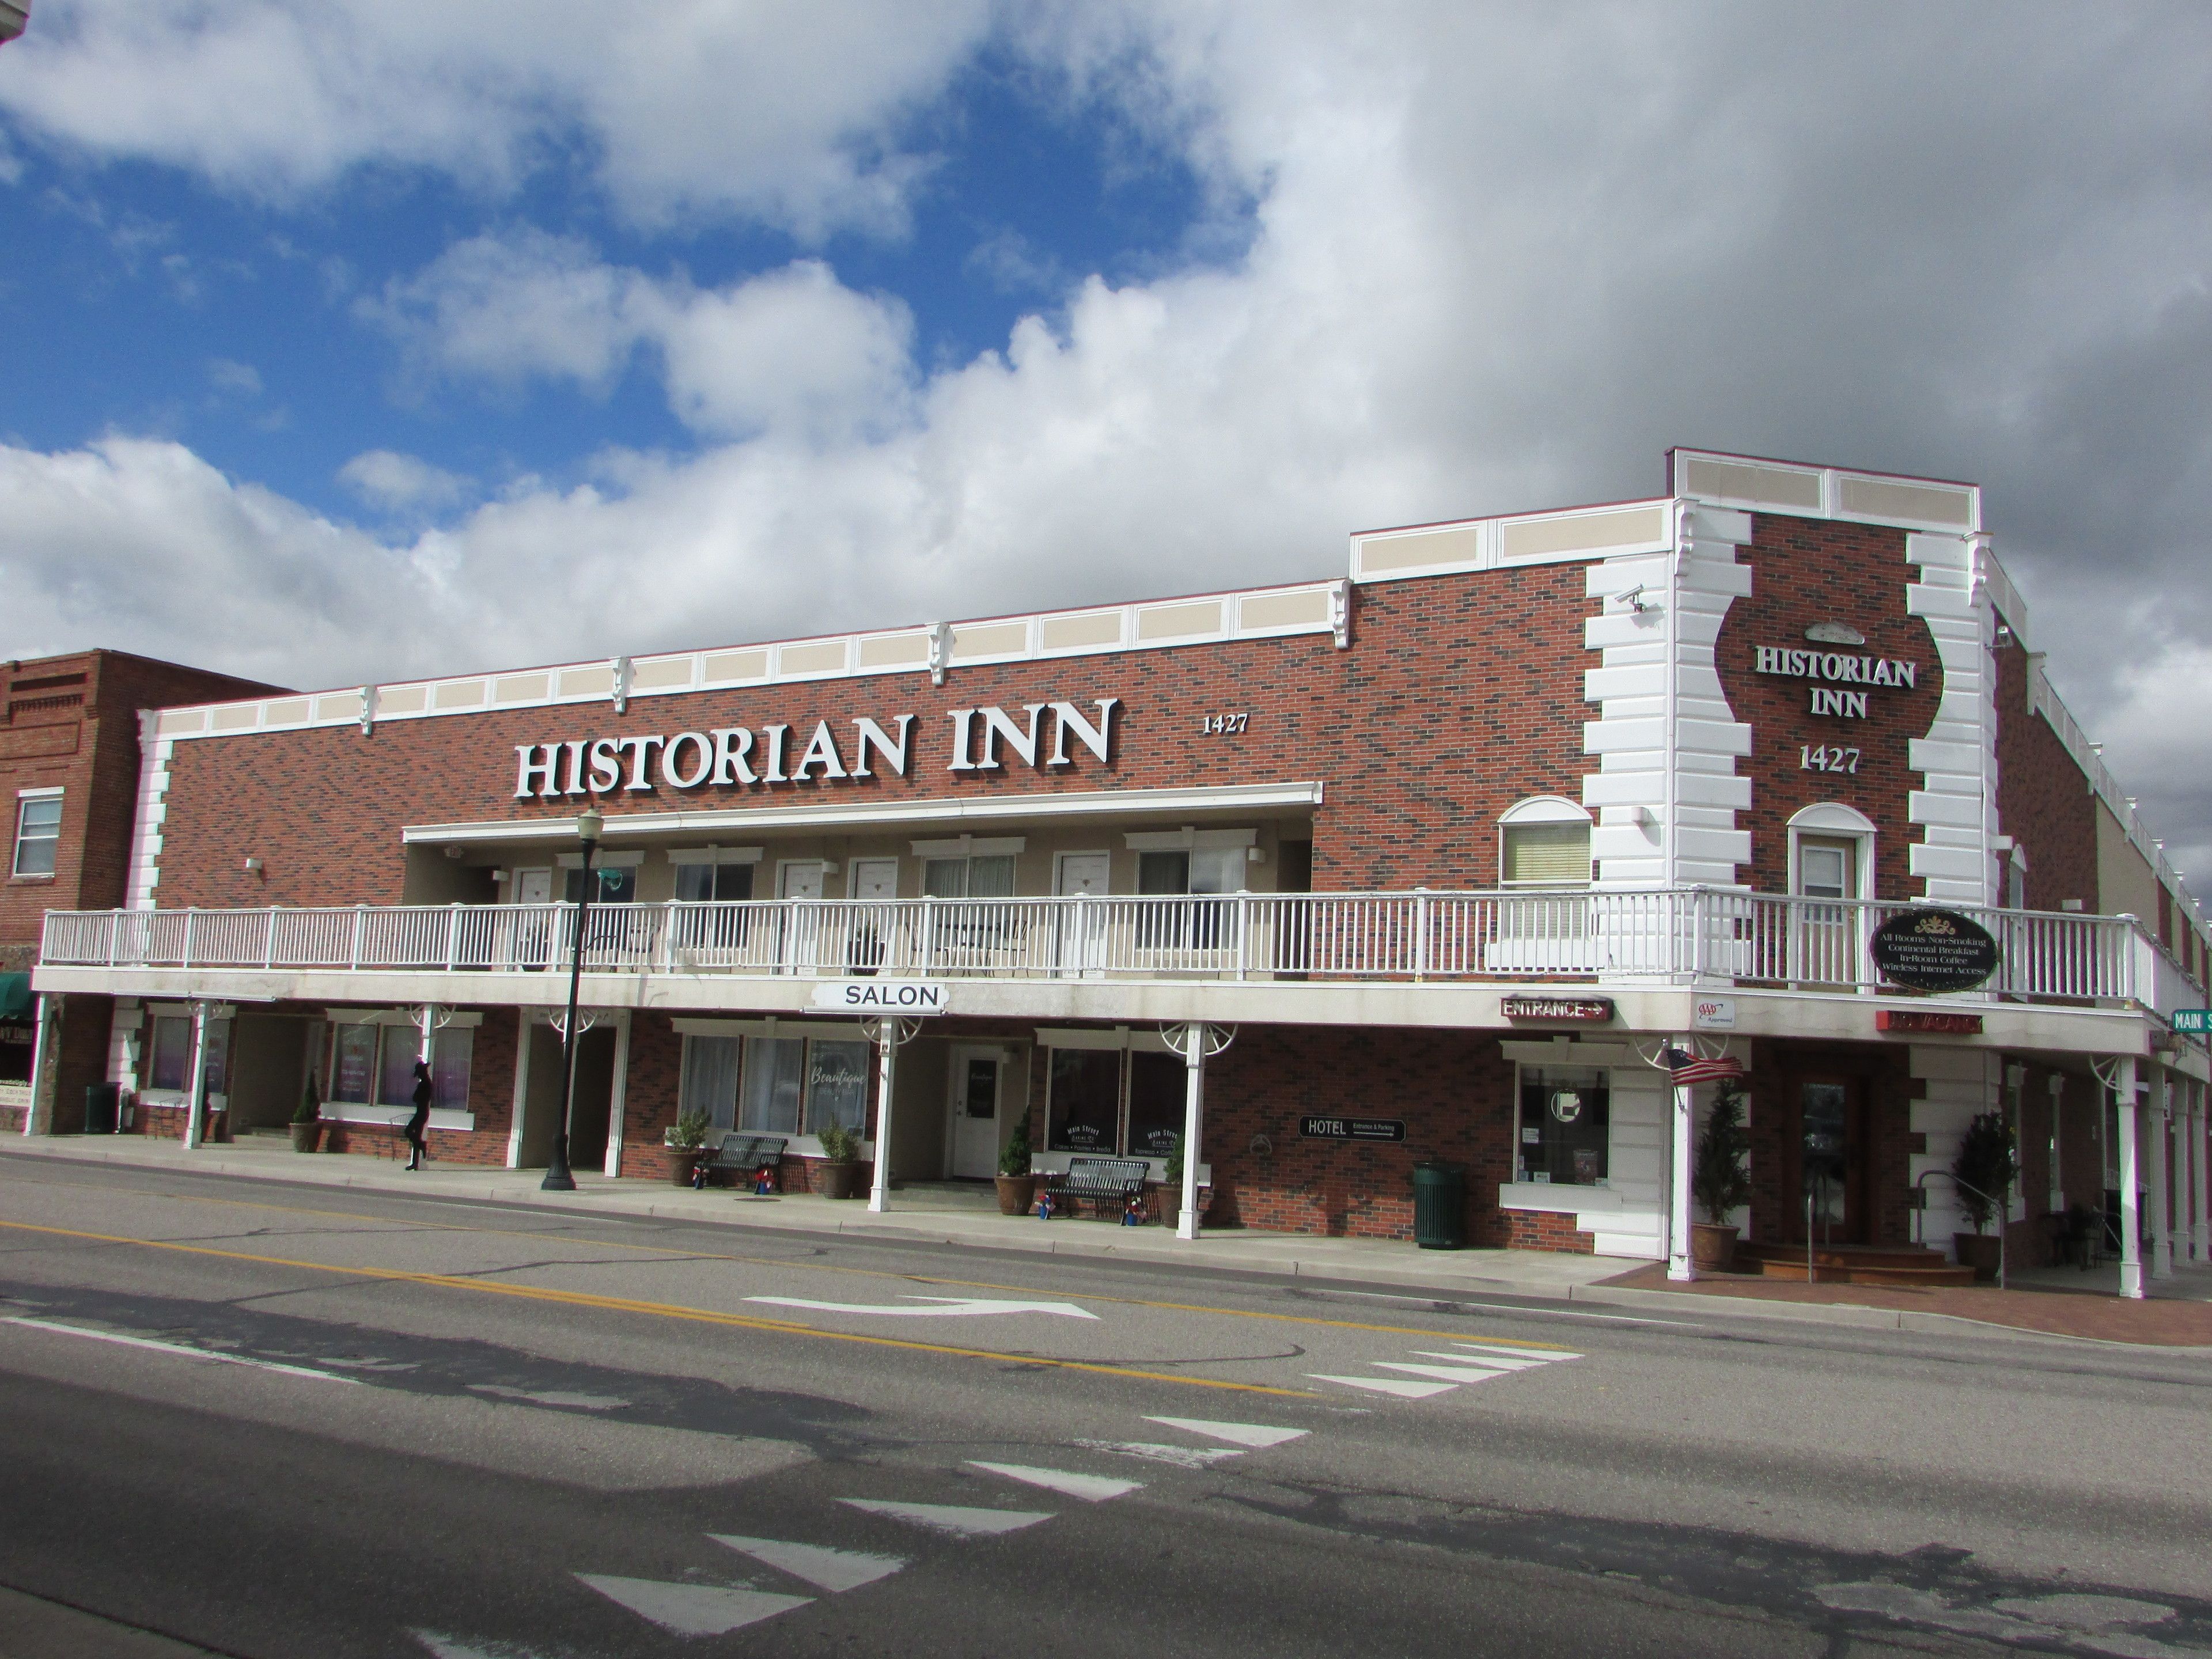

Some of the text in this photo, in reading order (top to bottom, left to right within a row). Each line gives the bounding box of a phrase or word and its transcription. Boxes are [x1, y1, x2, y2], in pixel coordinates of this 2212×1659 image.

[1754, 646, 1916, 689] HISTORIAN
[1810, 687, 1868, 719] INN
[1203, 713, 1248, 733] 1427
[513, 698, 1118, 799] HISTORIAN INN
[1800, 744, 1859, 774] 1427
[1895, 934, 1926, 943] Rooms
[1929, 936, 1986, 948] Non-Smoking
[1888, 944, 1979, 956] Continental Breakfast
[1900, 954, 1968, 965] In-Room Coffee
[1883, 963, 1987, 975] Wireless Internet Access
[846, 986, 939, 1005] SALON
[1503, 999, 1585, 1017] ENTRANCE
[2175, 1013, 2201, 1029] MAIN
[811, 1066, 866, 1089] Beautique
[1067, 1125, 1099, 1135] Main Street
[1147, 1129, 1178, 1139] Main Stree
[1309, 1120, 1346, 1135] HOTEL
